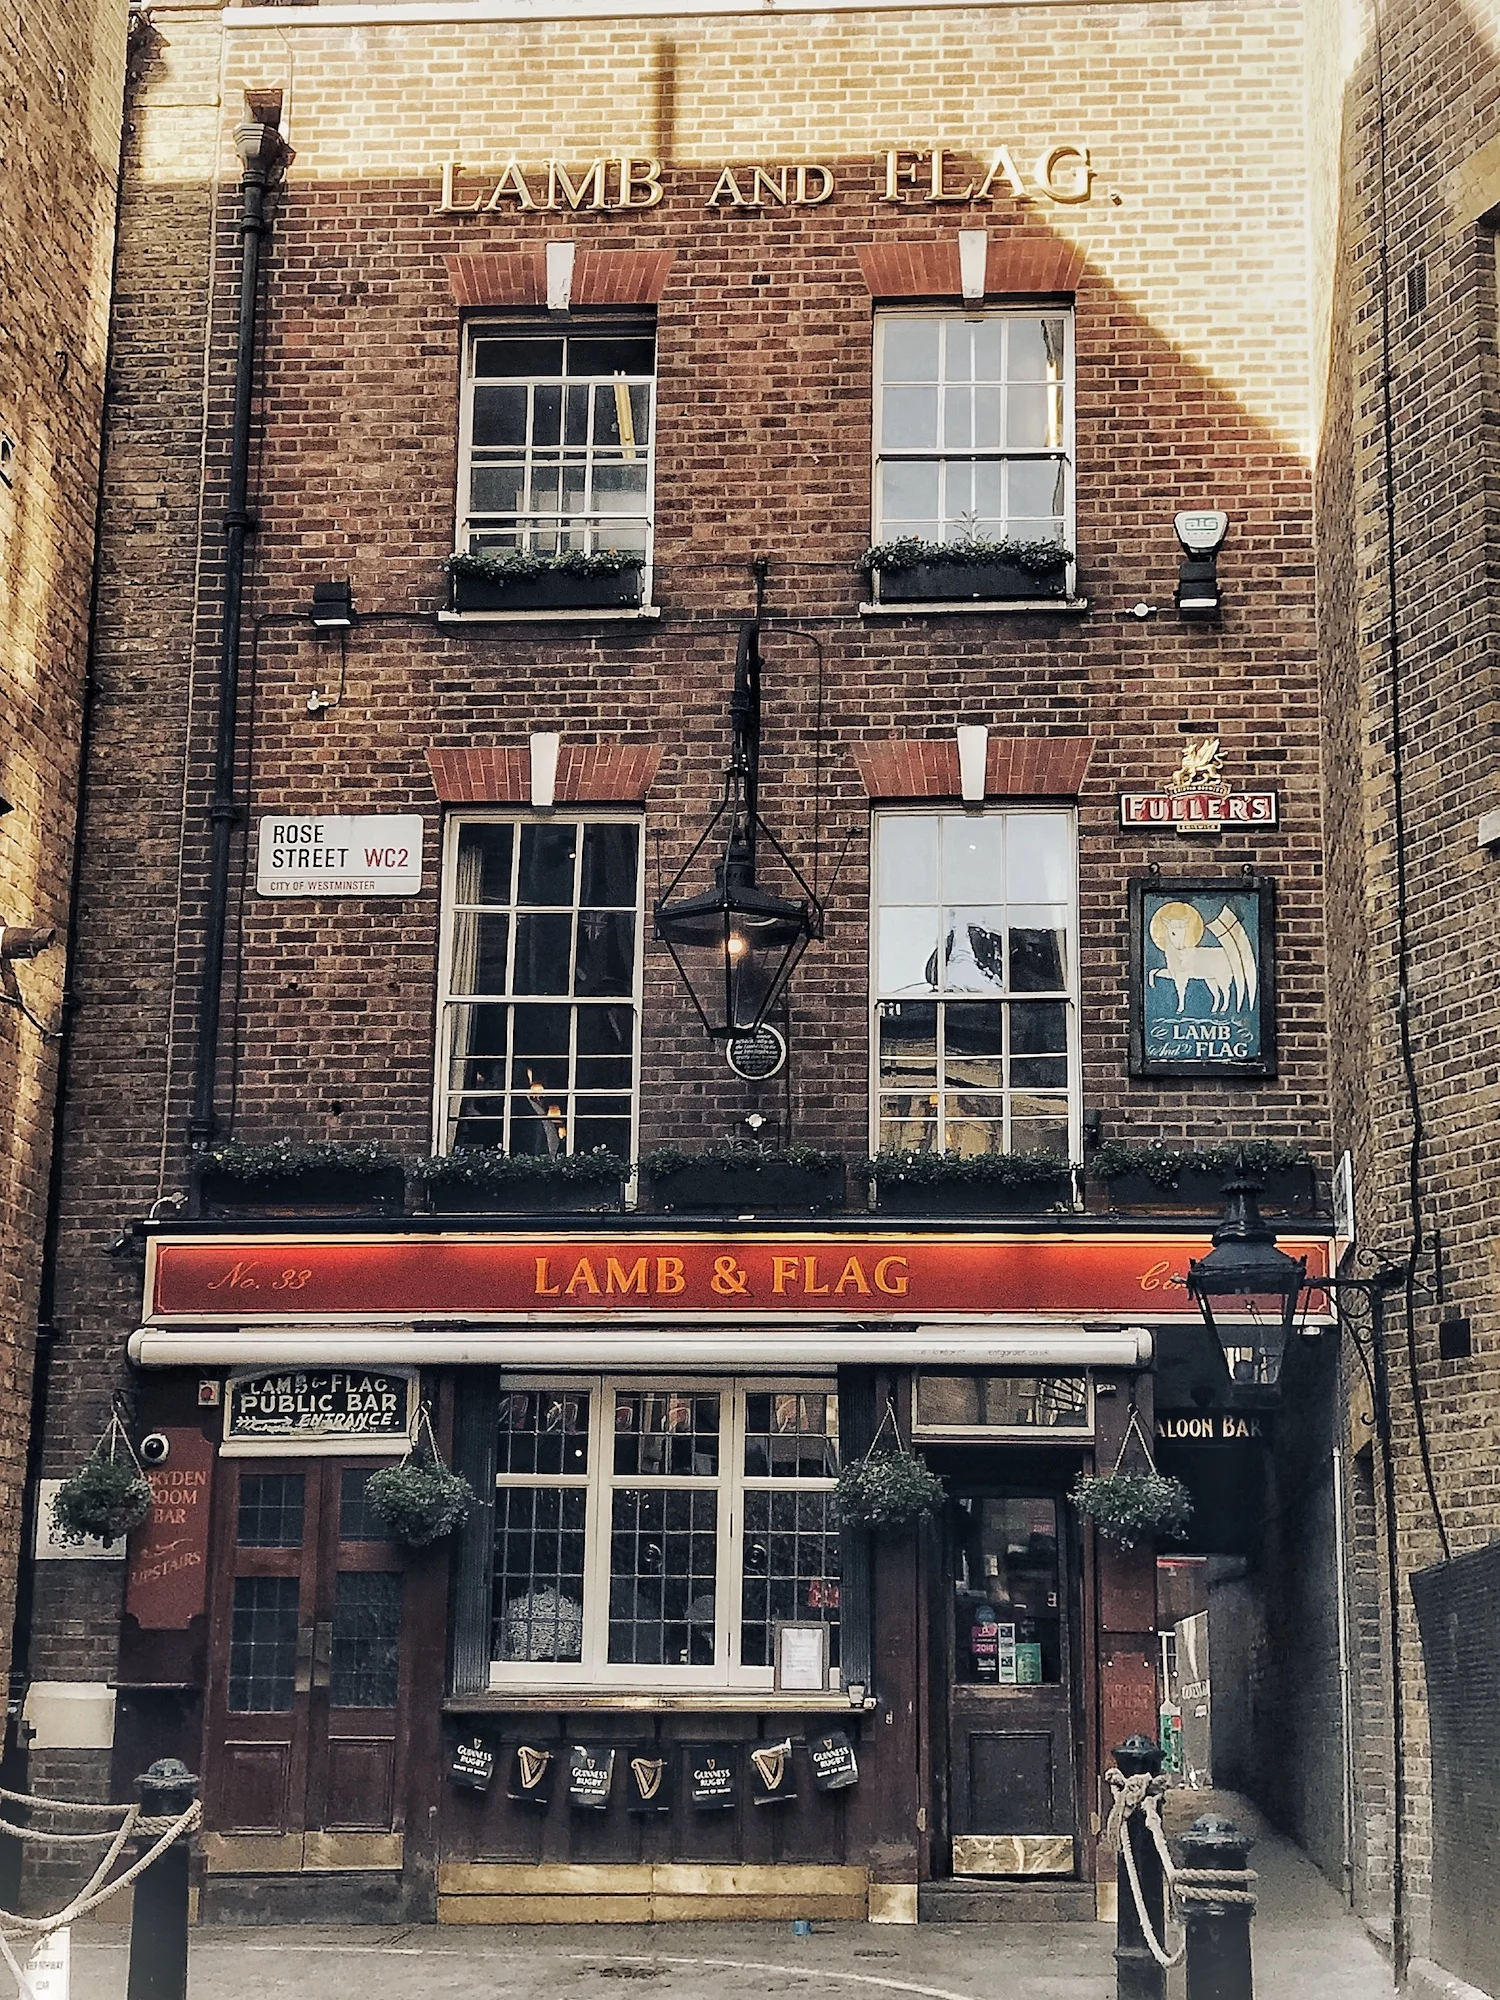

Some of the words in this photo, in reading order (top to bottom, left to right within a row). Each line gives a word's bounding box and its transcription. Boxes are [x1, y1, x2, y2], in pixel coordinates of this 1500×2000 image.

[435, 157, 663, 214] LAMB
[703, 163, 834, 208] AND
[1130, 797, 1268, 821] FULLER'S
[273, 824, 325, 844] ROSE
[272, 848, 349, 868] STREET
[364, 848, 409, 868] WC2
[270, 881, 290, 891] CITY
[293, 881, 305, 891] OF
[308, 880, 376, 890] WESTMINSTER
[1172, 1024, 1232, 1041] LAMB
[1195, 1041, 1249, 1058] FLAG
[207, 1261, 260, 1290] No.
[271, 1268, 313, 1290] 33
[533, 1256, 688, 1295] LAMB
[709, 1255, 749, 1295] &
[771, 1255, 911, 1296] FLAG
[251, 1375, 309, 1395] LAMB
[240, 1394, 334, 1414] PUBLIC
[346, 1393, 398, 1413] BAR
[1156, 1418, 1214, 1439] ALOON
[1222, 1415, 1263, 1438] BAR
[154, 1508, 187, 1524] BAR
[131, 1551, 202, 1584] UPSTAIRS
[693, 1769, 732, 1781] GUINNESS
[700, 1777, 727, 1787] RUGBY
